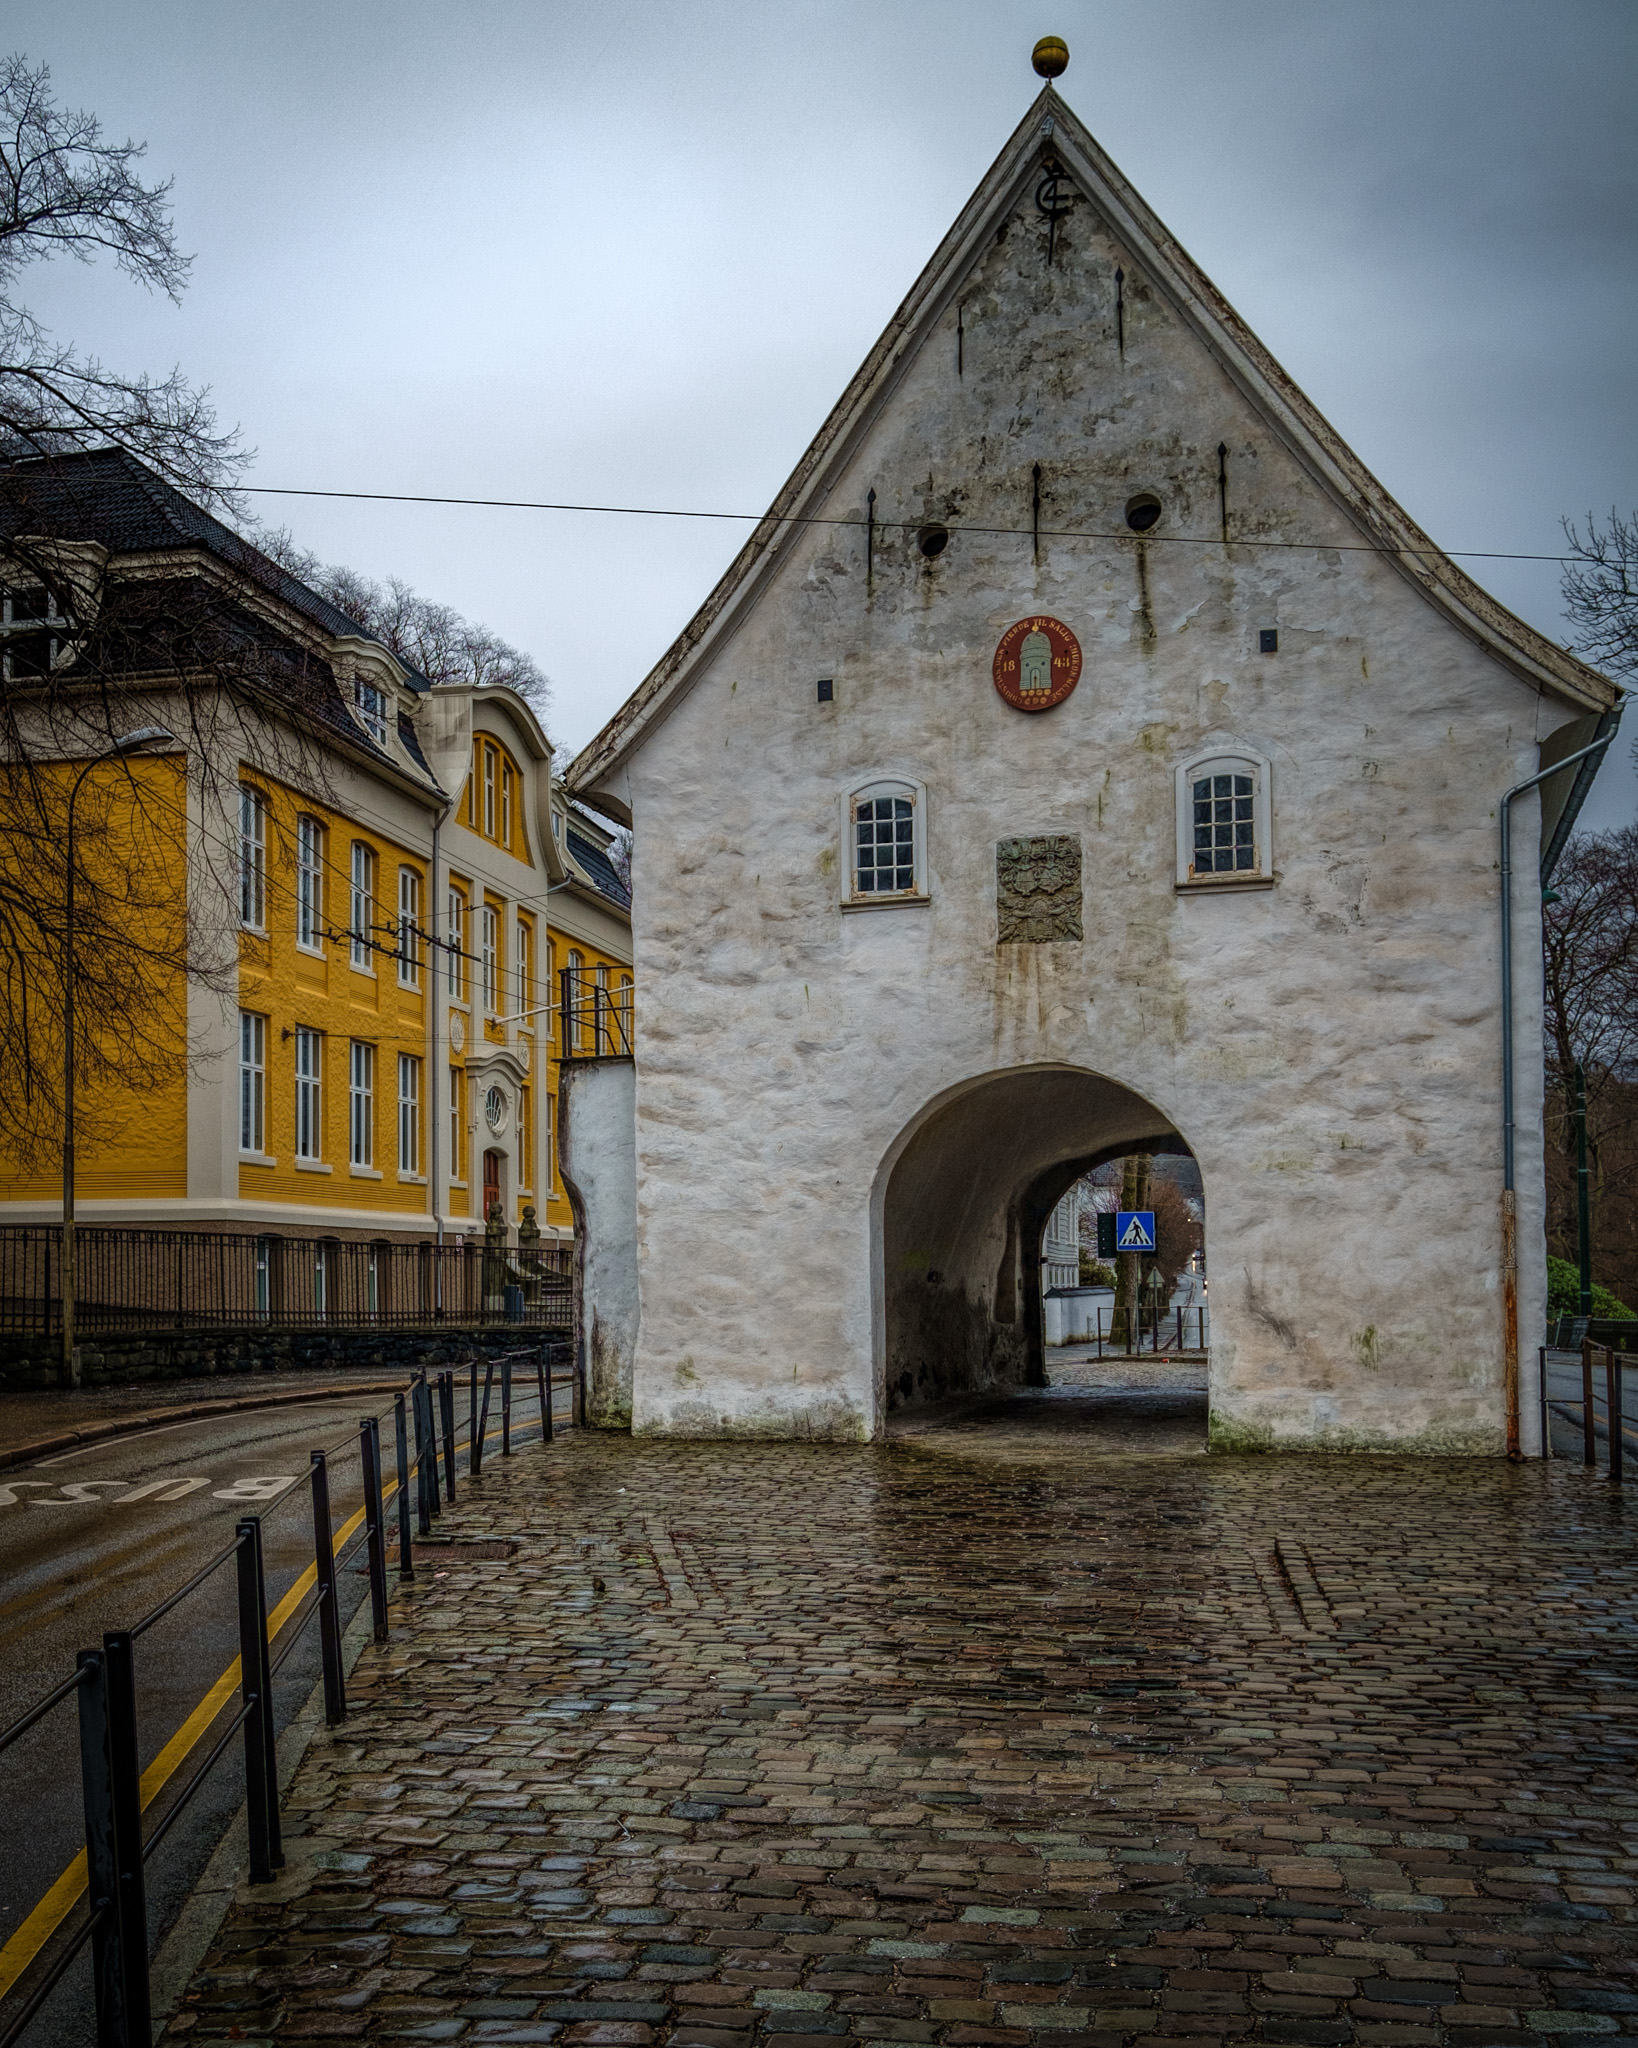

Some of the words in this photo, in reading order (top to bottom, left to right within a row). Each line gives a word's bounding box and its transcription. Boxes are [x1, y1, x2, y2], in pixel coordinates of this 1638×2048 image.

[1032, 619, 1047, 627] TIL
[1049, 621, 1073, 642] SALIG
[995, 649, 1005, 666] DEN
[1003, 660, 1016, 673] 18
[995, 668, 1022, 704] CHRISTIAN
